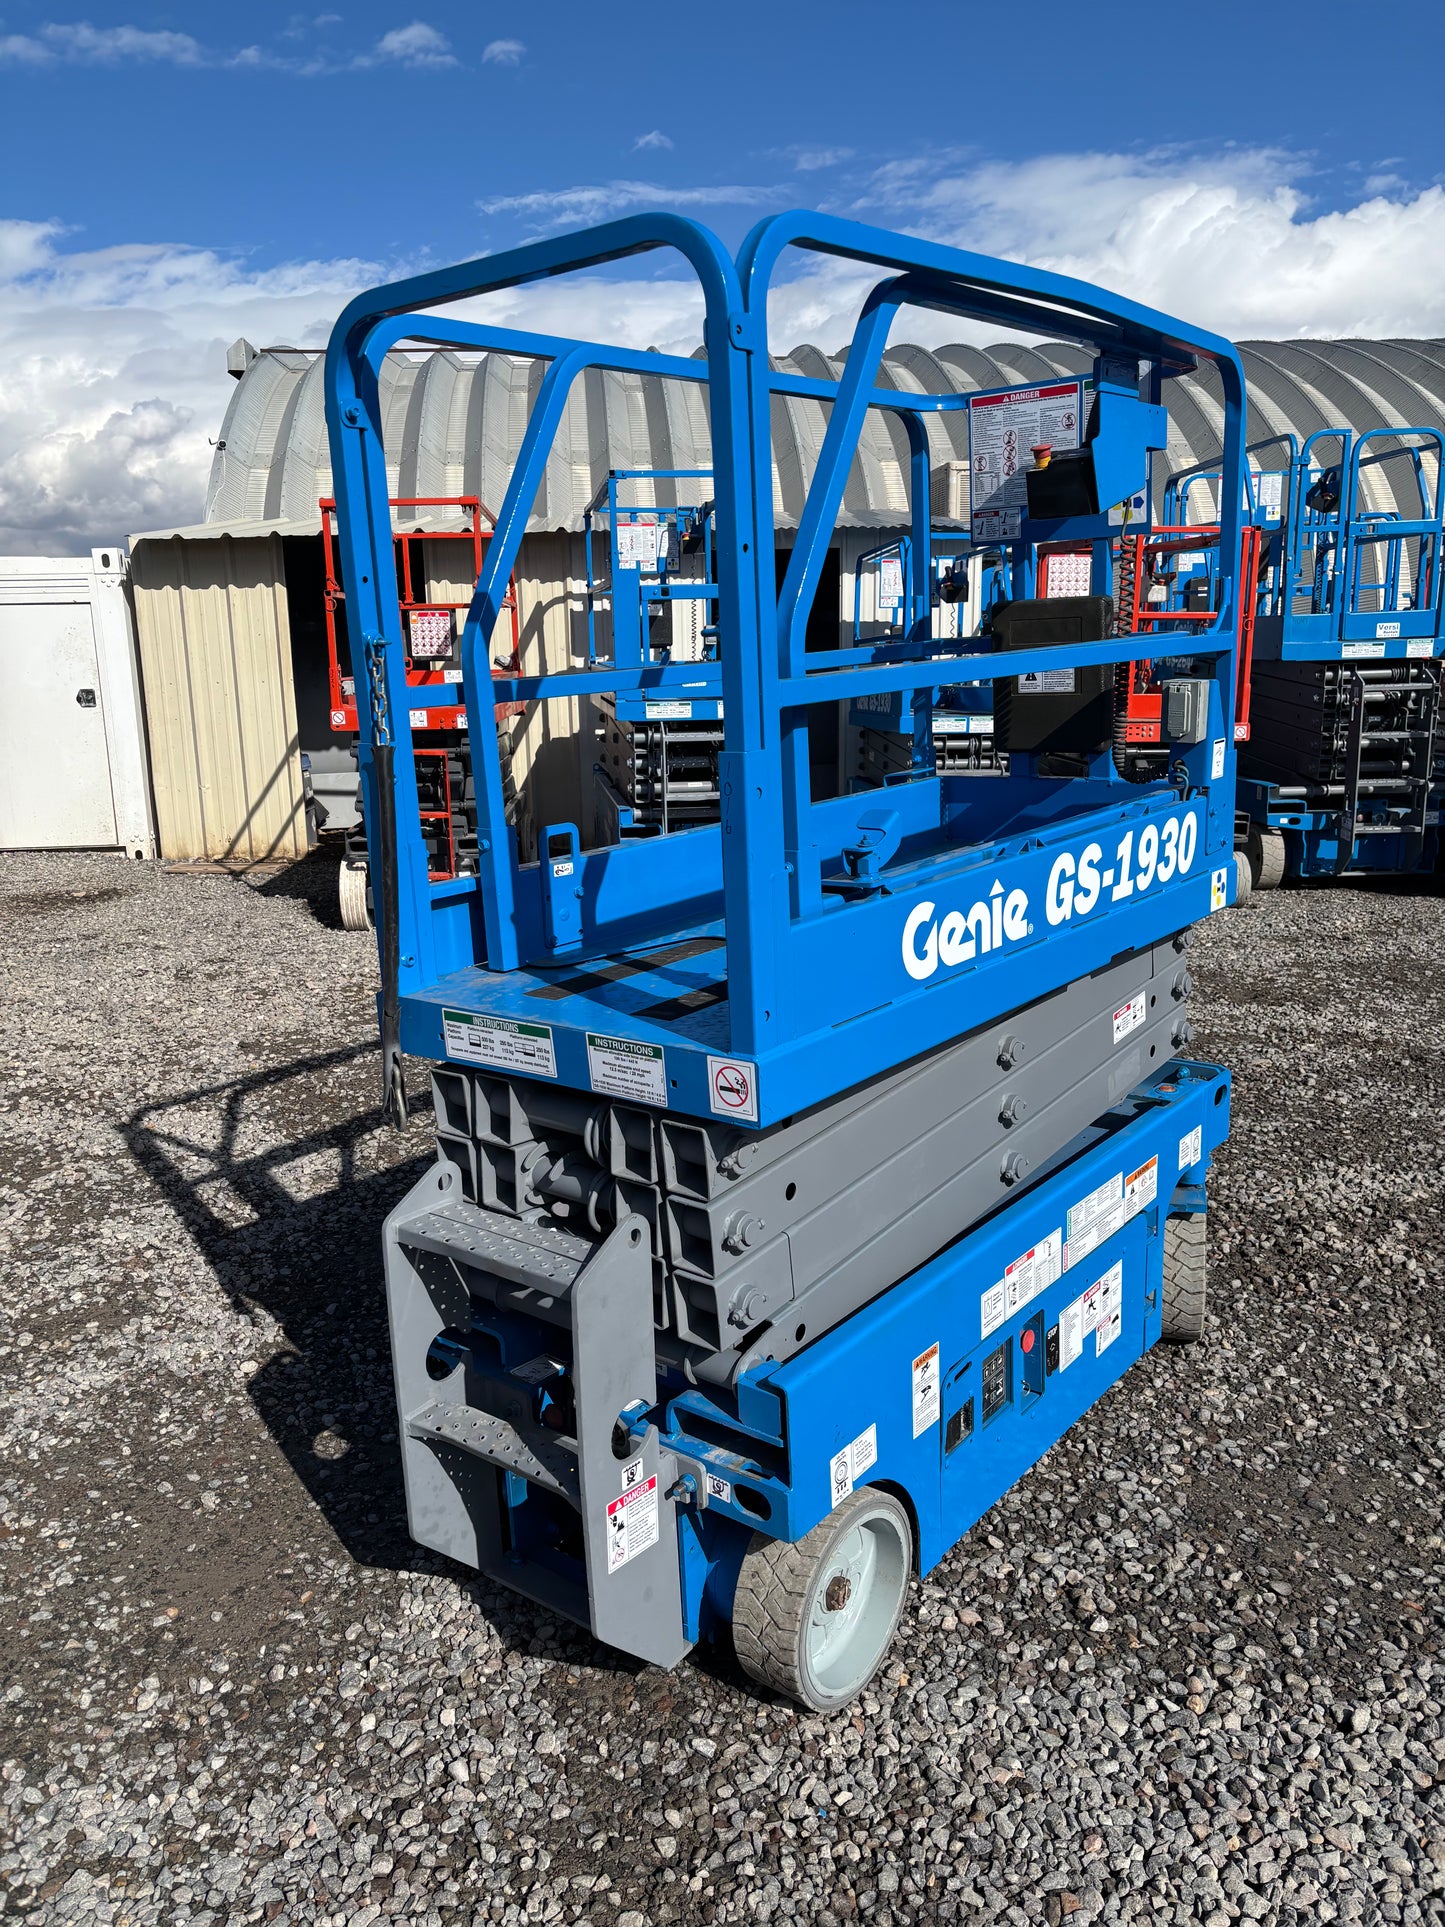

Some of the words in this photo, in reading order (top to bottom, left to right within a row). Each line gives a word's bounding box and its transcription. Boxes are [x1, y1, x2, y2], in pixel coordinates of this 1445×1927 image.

[1010, 390, 1040, 401] DANGER
[902, 878, 1029, 980] Genie
[1045, 811, 1197, 926] GS-1930
[473, 1016, 519, 1033] INSTRUCTIONS
[595, 1038, 653, 1056] INSTRUCTIONS
[1047, 1325, 1058, 1340] STOP
[623, 1482, 649, 1505] DANGER
